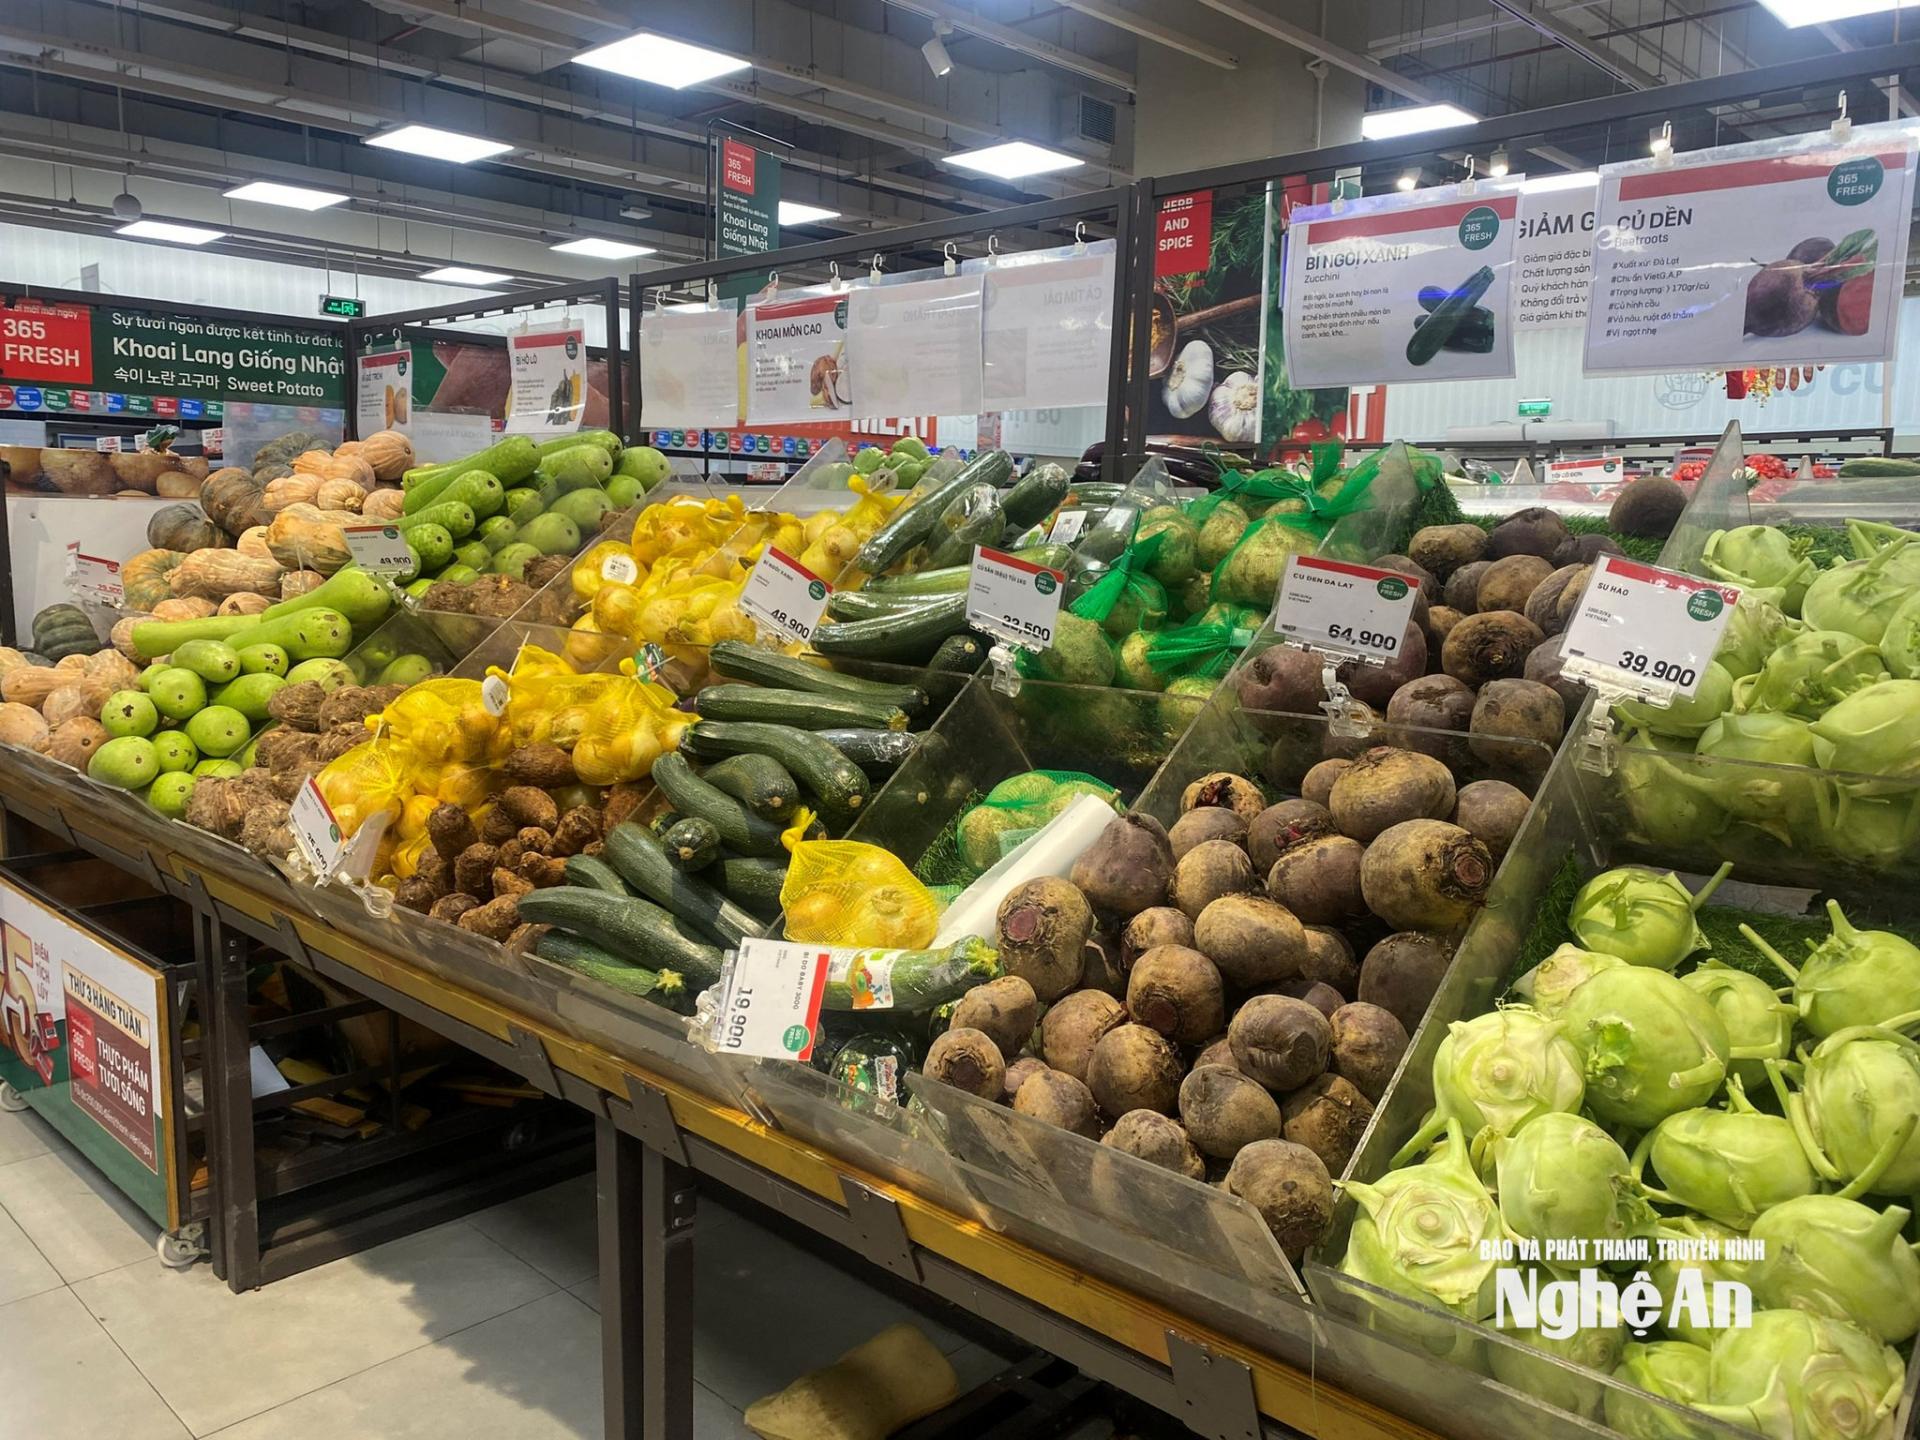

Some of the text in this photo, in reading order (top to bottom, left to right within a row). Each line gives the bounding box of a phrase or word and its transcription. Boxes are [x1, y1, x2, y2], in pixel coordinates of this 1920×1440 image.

[727, 158, 742, 170] 365
[727, 170, 751, 186] FRESH
[1837, 173, 1858, 185] 365
[1835, 184, 1874, 197] FRESH
[723, 211, 768, 237] Khoai Lang
[1164, 217, 1189, 232] AND
[1465, 222, 1481, 232] 365
[1617, 209, 1645, 231] CỦ
[1159, 235, 1193, 251] SPICE
[1464, 232, 1492, 242] FRESH
[1363, 246, 1409, 264] XANH
[1304, 272, 1340, 284] Zucchini
[4, 318, 46, 340] 365
[112, 312, 133, 329] Sự
[136, 316, 166, 330] tươi
[206, 323, 240, 339] được
[755, 323, 822, 340] KHOAI MÔN CAO
[4, 343, 80, 367] FRESH
[112, 337, 176, 361] Khoai
[182, 343, 234, 369] Lang
[239, 348, 297, 374] Giống
[113, 366, 220, 390] 속이 노란 고구마
[227, 376, 324, 398] Sweet Potato
[1307, 576, 1323, 584] DEN
[1324, 578, 1336, 586] DA
[1338, 581, 1354, 589] LAT
[1597, 582, 1630, 597] SU HAO
[1689, 606, 1715, 618] FRESH
[1693, 598, 1707, 608] 365
[770, 609, 810, 639] 48,900
[1328, 624, 1397, 651] 64,900
[1618, 650, 1696, 687] 39,900
[797, 971, 806, 991] BABY
[69, 973, 86, 998] THỨ
[86, 984, 92, 1004] 3
[93, 985, 116, 1020] HÀNG
[726, 986, 753, 1049] 19,900
[73, 1048, 95, 1076] FRESH
[97, 1037, 149, 1093] THỰC PHẨM
[98, 1064, 146, 1116] TƯƠI SỐNG
